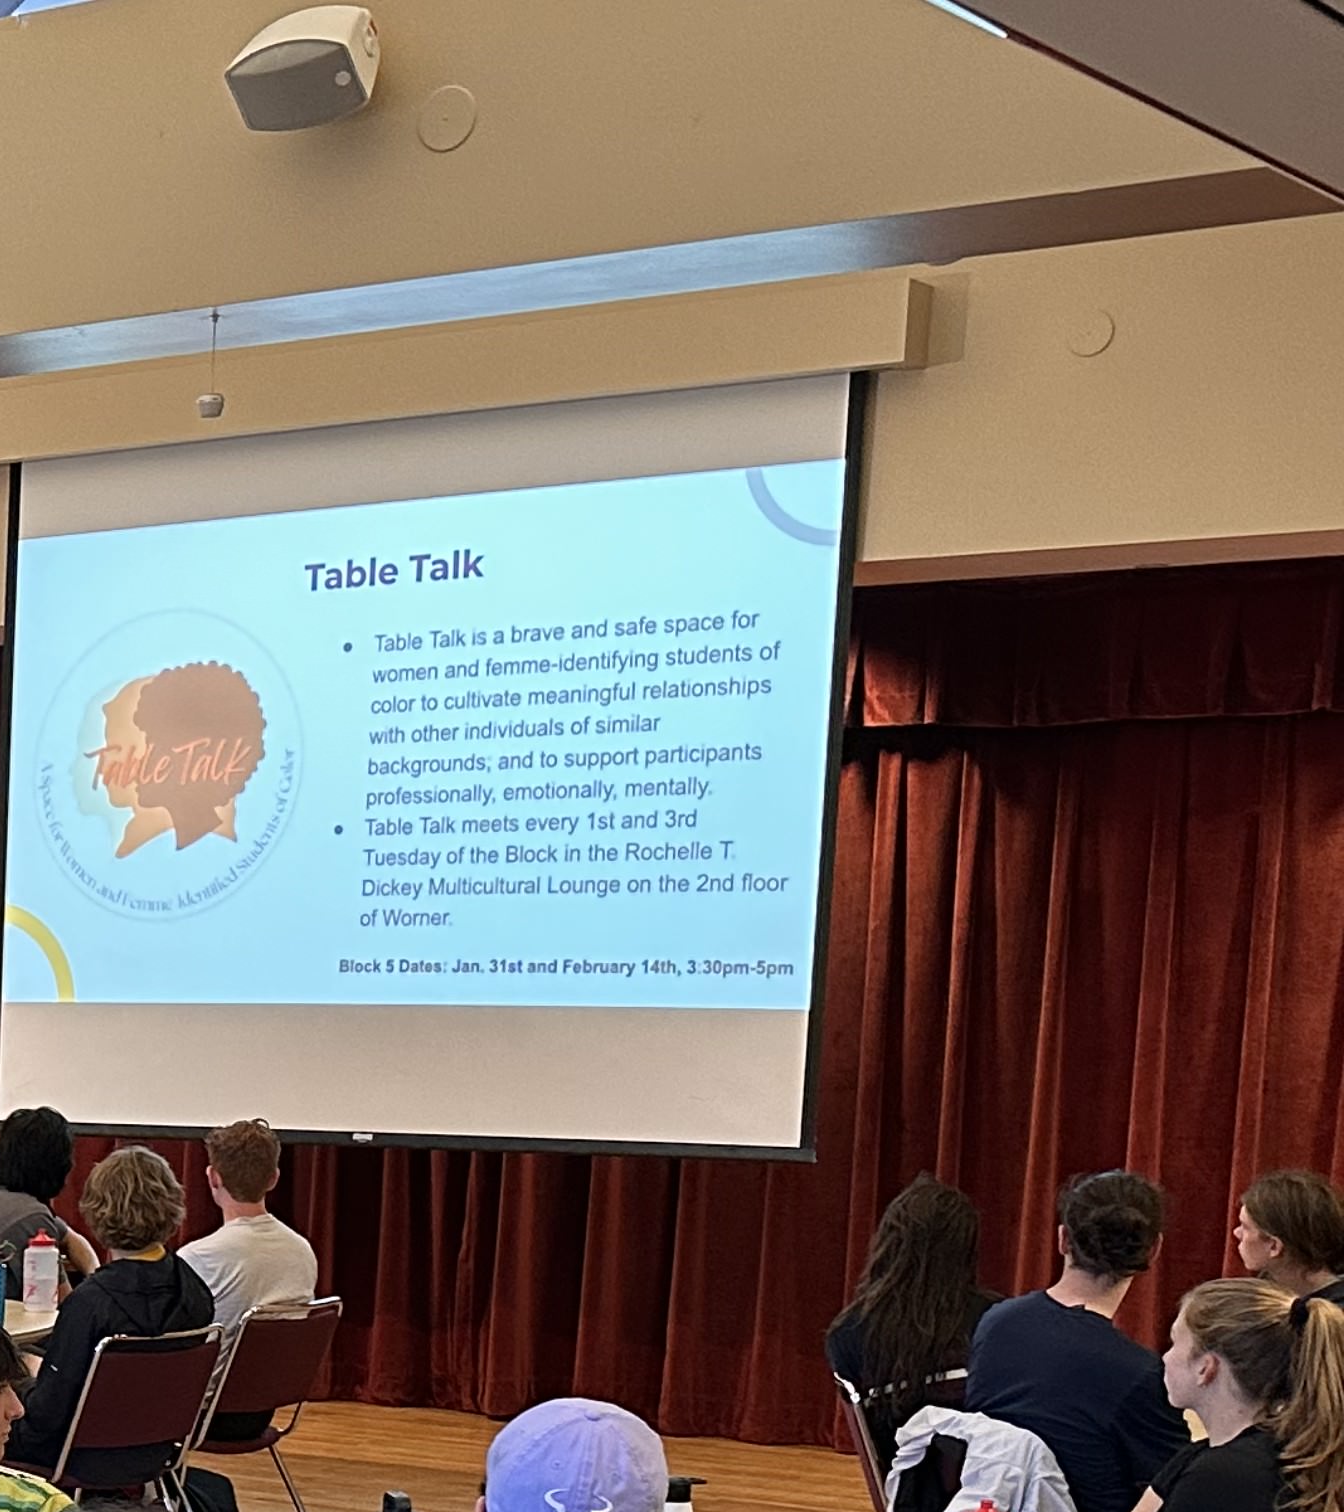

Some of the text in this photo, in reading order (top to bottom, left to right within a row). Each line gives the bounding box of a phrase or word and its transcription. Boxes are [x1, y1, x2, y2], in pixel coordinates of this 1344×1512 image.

[305, 549, 485, 592] Table Talk
[375, 610, 760, 652] Table Talk is a brave and safe space for
[372, 640, 781, 684] women and femme-identifying students of
[371, 676, 772, 715] color to cultivate meaningful relationships
[369, 714, 661, 744] with other individuals of similar
[83, 737, 251, 791] Table Talk
[280, 748, 295, 790] Color
[498, 751, 533, 770] and
[540, 751, 558, 769] to
[564, 746, 639, 771] support
[645, 742, 762, 769] participants
[38, 774, 54, 819] Space
[277, 792, 288, 813] of
[366, 776, 713, 810] professionally, emotionally, mentally.
[49, 820, 64, 842] for
[365, 809, 697, 836] Table Talk meets every 1st and 3rd
[236, 814, 281, 875] Students
[363, 849, 441, 869] Tuesday
[446, 847, 464, 865] of
[470, 847, 498, 864] the
[505, 845, 558, 863] Block
[564, 844, 581, 862] in
[588, 844, 618, 862] the
[625, 842, 712, 861] Rochelle
[61, 840, 97, 890] Women
[96, 884, 122, 904] and
[362, 873, 789, 899] Dickey Multicultural Lounge on the 2nd floor
[121, 896, 172, 912] Femme
[360, 909, 453, 927] of Worner.
[339, 959, 793, 978] Block 5 Dates: Jan. 31st and February 14th, 3:30pm-5pm
